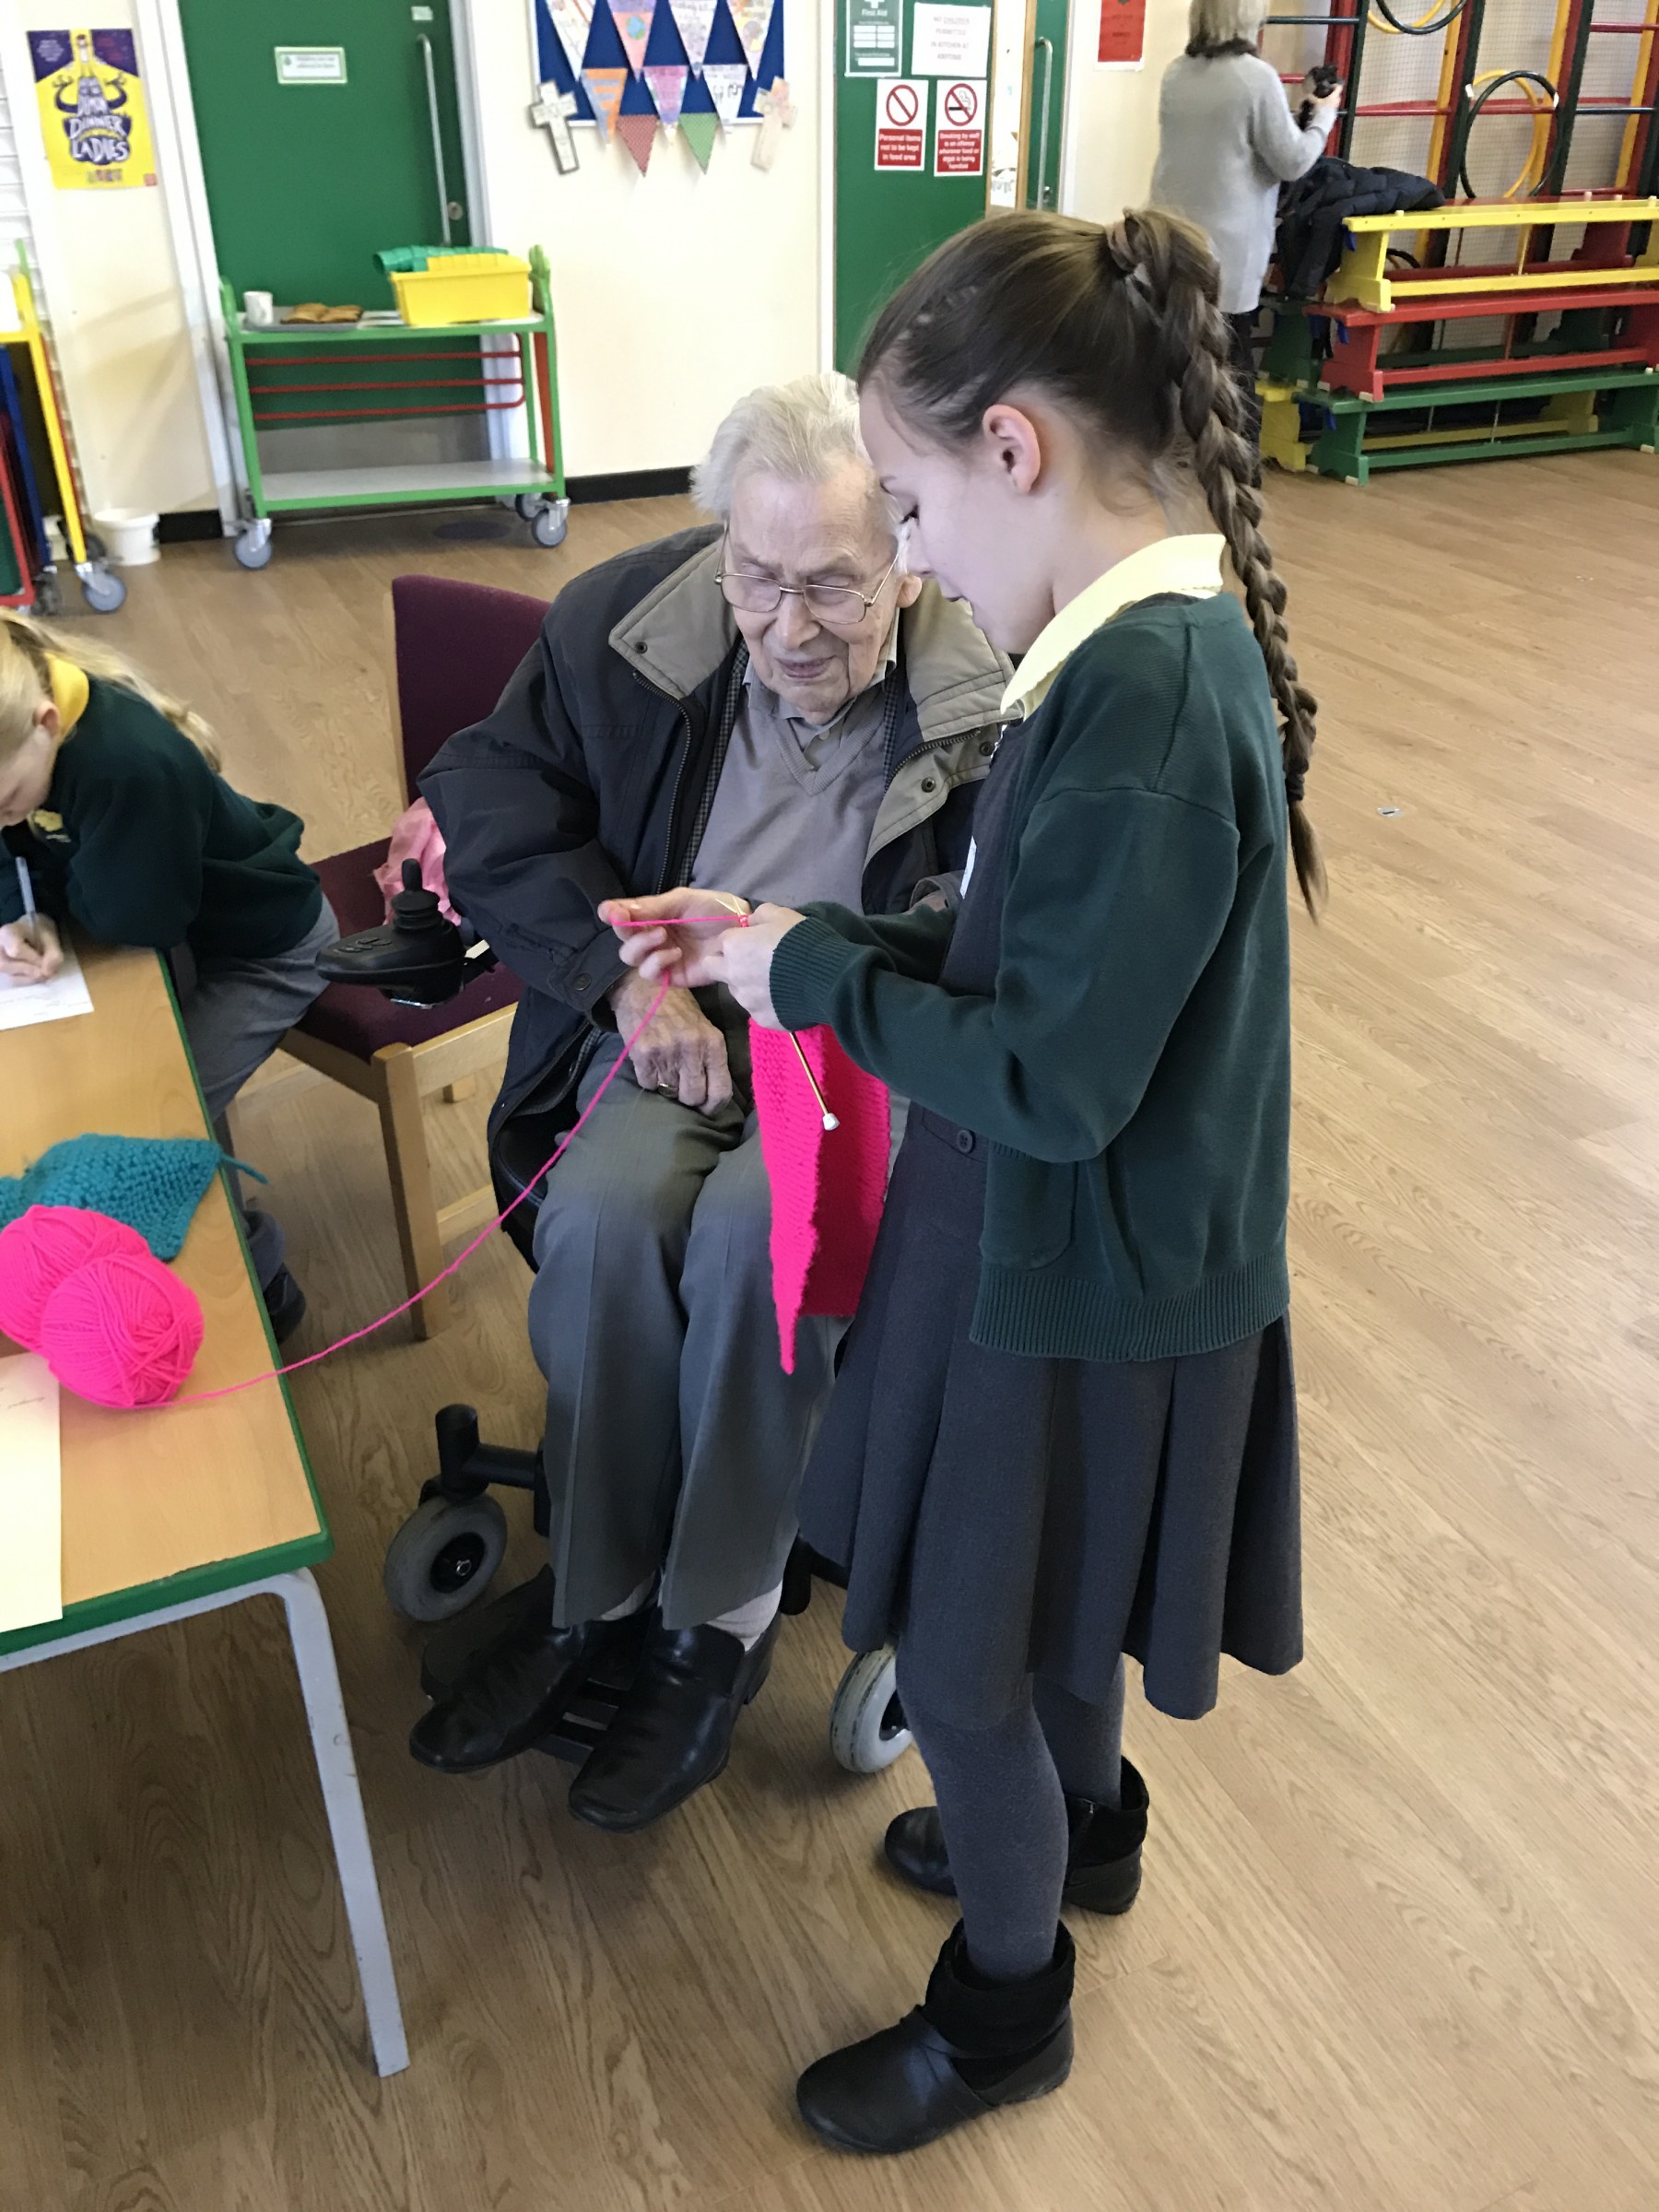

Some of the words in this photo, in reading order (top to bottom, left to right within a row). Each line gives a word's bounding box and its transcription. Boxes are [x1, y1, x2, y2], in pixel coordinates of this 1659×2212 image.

[69, 114, 127, 138] DINNER
[879, 134, 905, 142] Personal
[72, 137, 129, 162] LADIES
